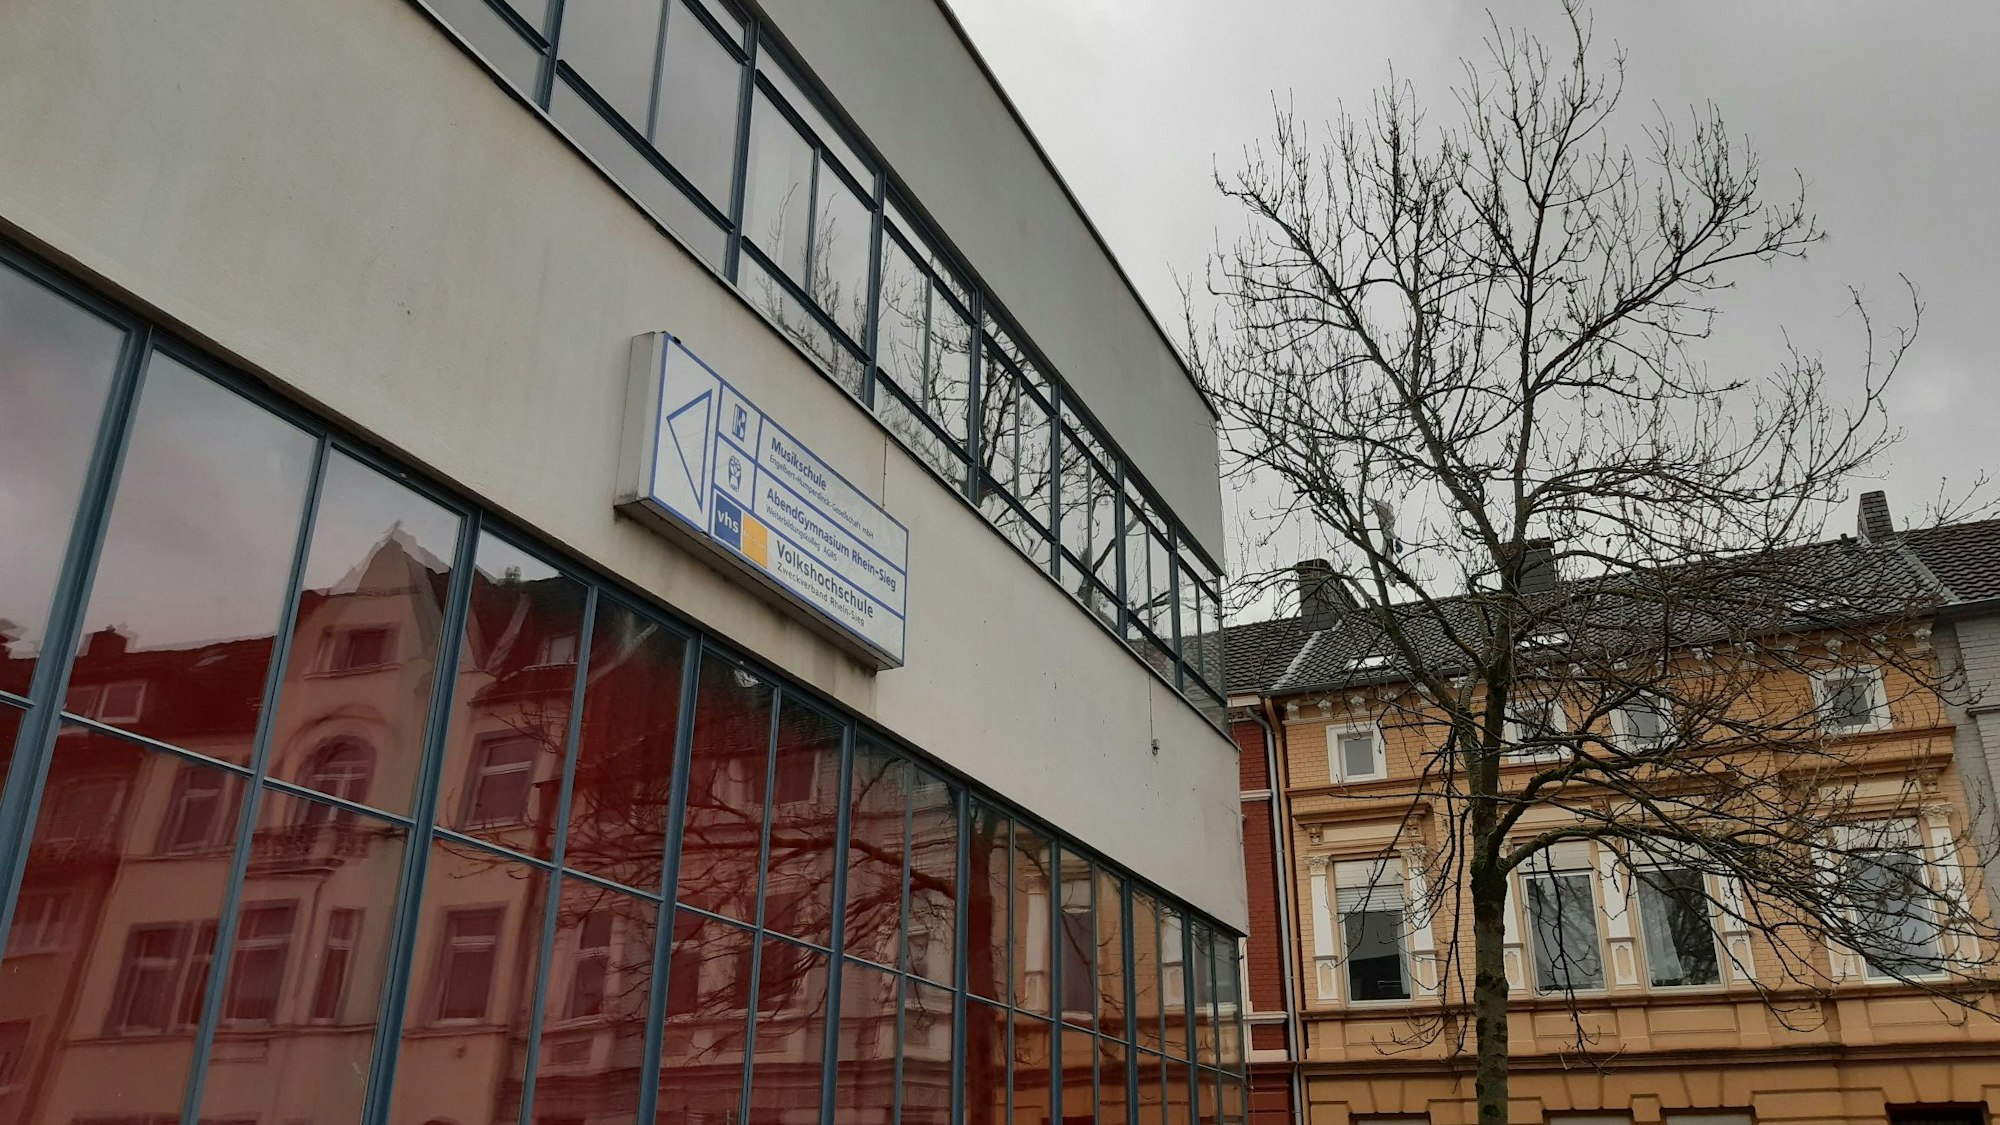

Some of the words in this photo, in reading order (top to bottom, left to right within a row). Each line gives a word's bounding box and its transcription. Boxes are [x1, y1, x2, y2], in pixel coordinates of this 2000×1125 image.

[771, 437, 827, 491] Musikschule
[717, 510, 739, 533] vhs
[766, 504, 821, 552] Weiterbildungskolleg
[767, 488, 850, 557] AbendGymnasium
[852, 549, 896, 592] Rhein-Sieg
[777, 540, 873, 618] Volkshochschule
[777, 562, 828, 601] Zweckverband
[830, 597, 865, 627] Rhein-Sieg
